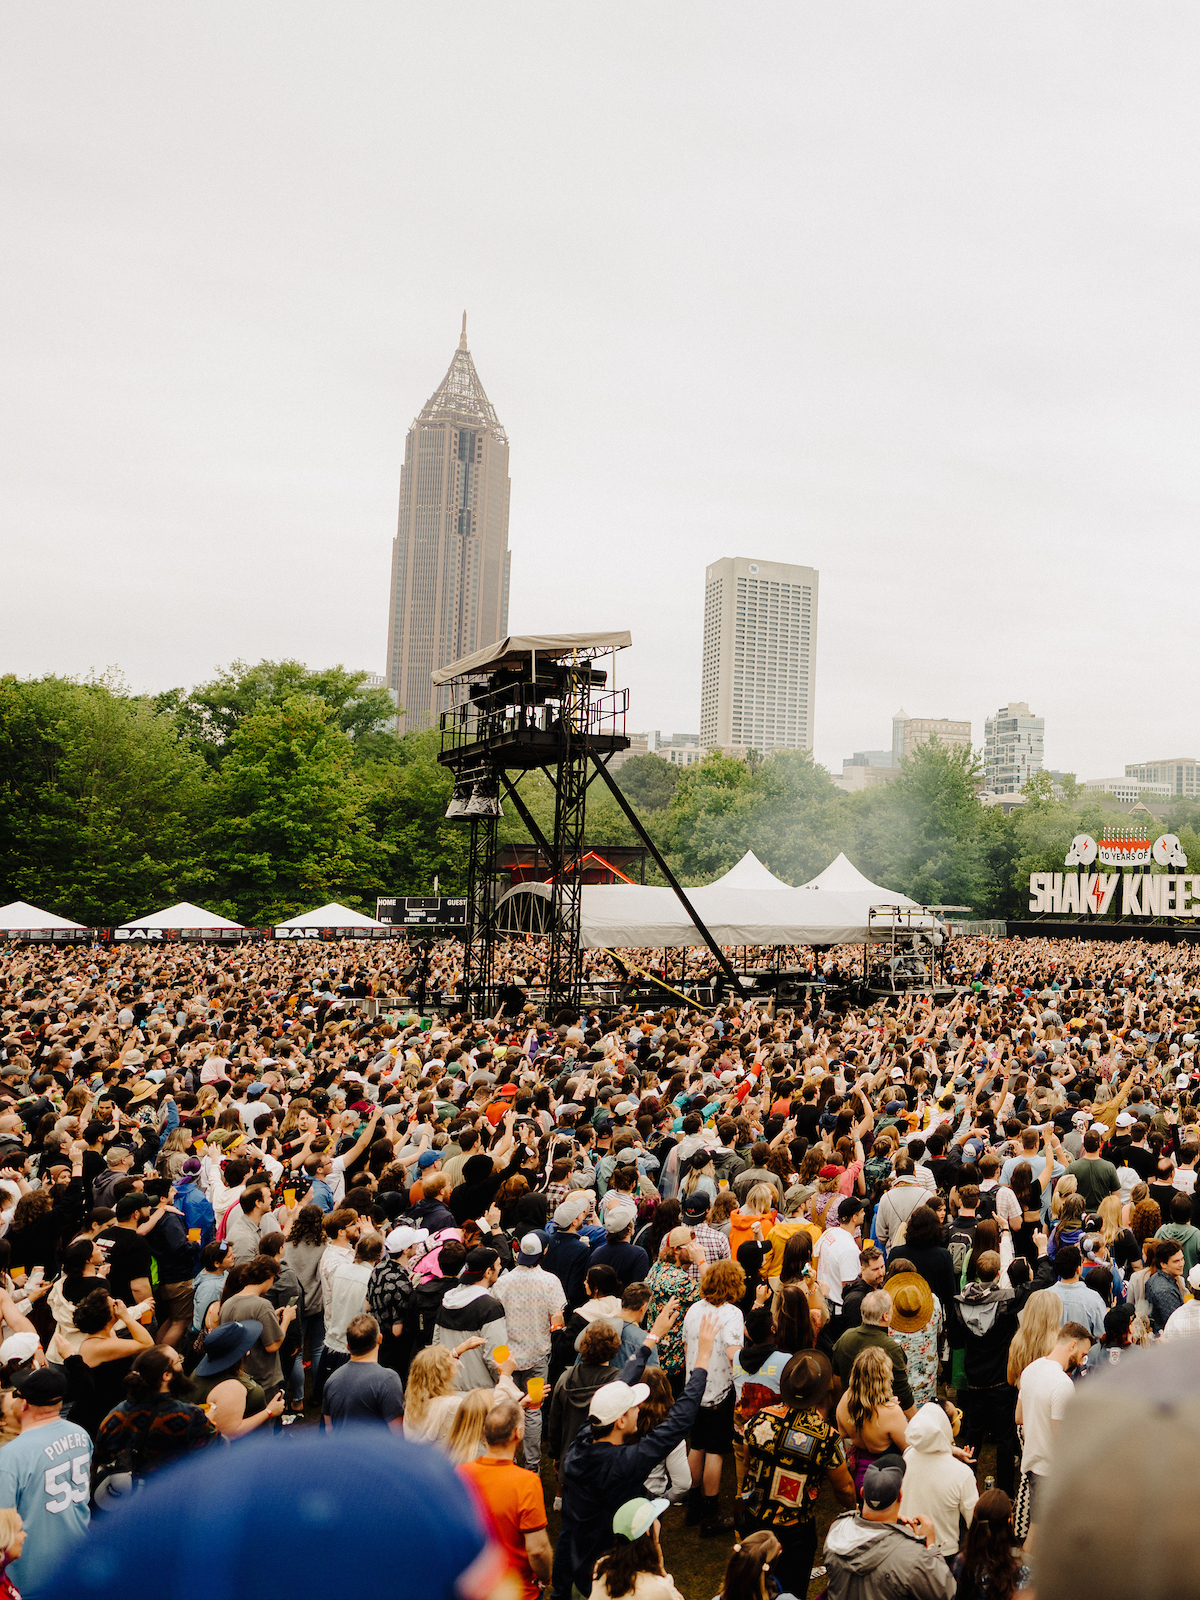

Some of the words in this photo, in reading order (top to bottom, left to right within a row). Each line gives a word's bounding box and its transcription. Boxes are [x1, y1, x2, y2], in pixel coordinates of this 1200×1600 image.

[1101, 851, 1109, 860] 10
[1111, 852, 1136, 861] YEARS
[1138, 851, 1148, 860] OF
[1029, 872, 1120, 914] SHAKY
[114, 929, 163, 940] BAR
[275, 928, 319, 938] BAR
[44, 1433, 88, 1461] POWERS
[44, 1452, 90, 1514] 55
